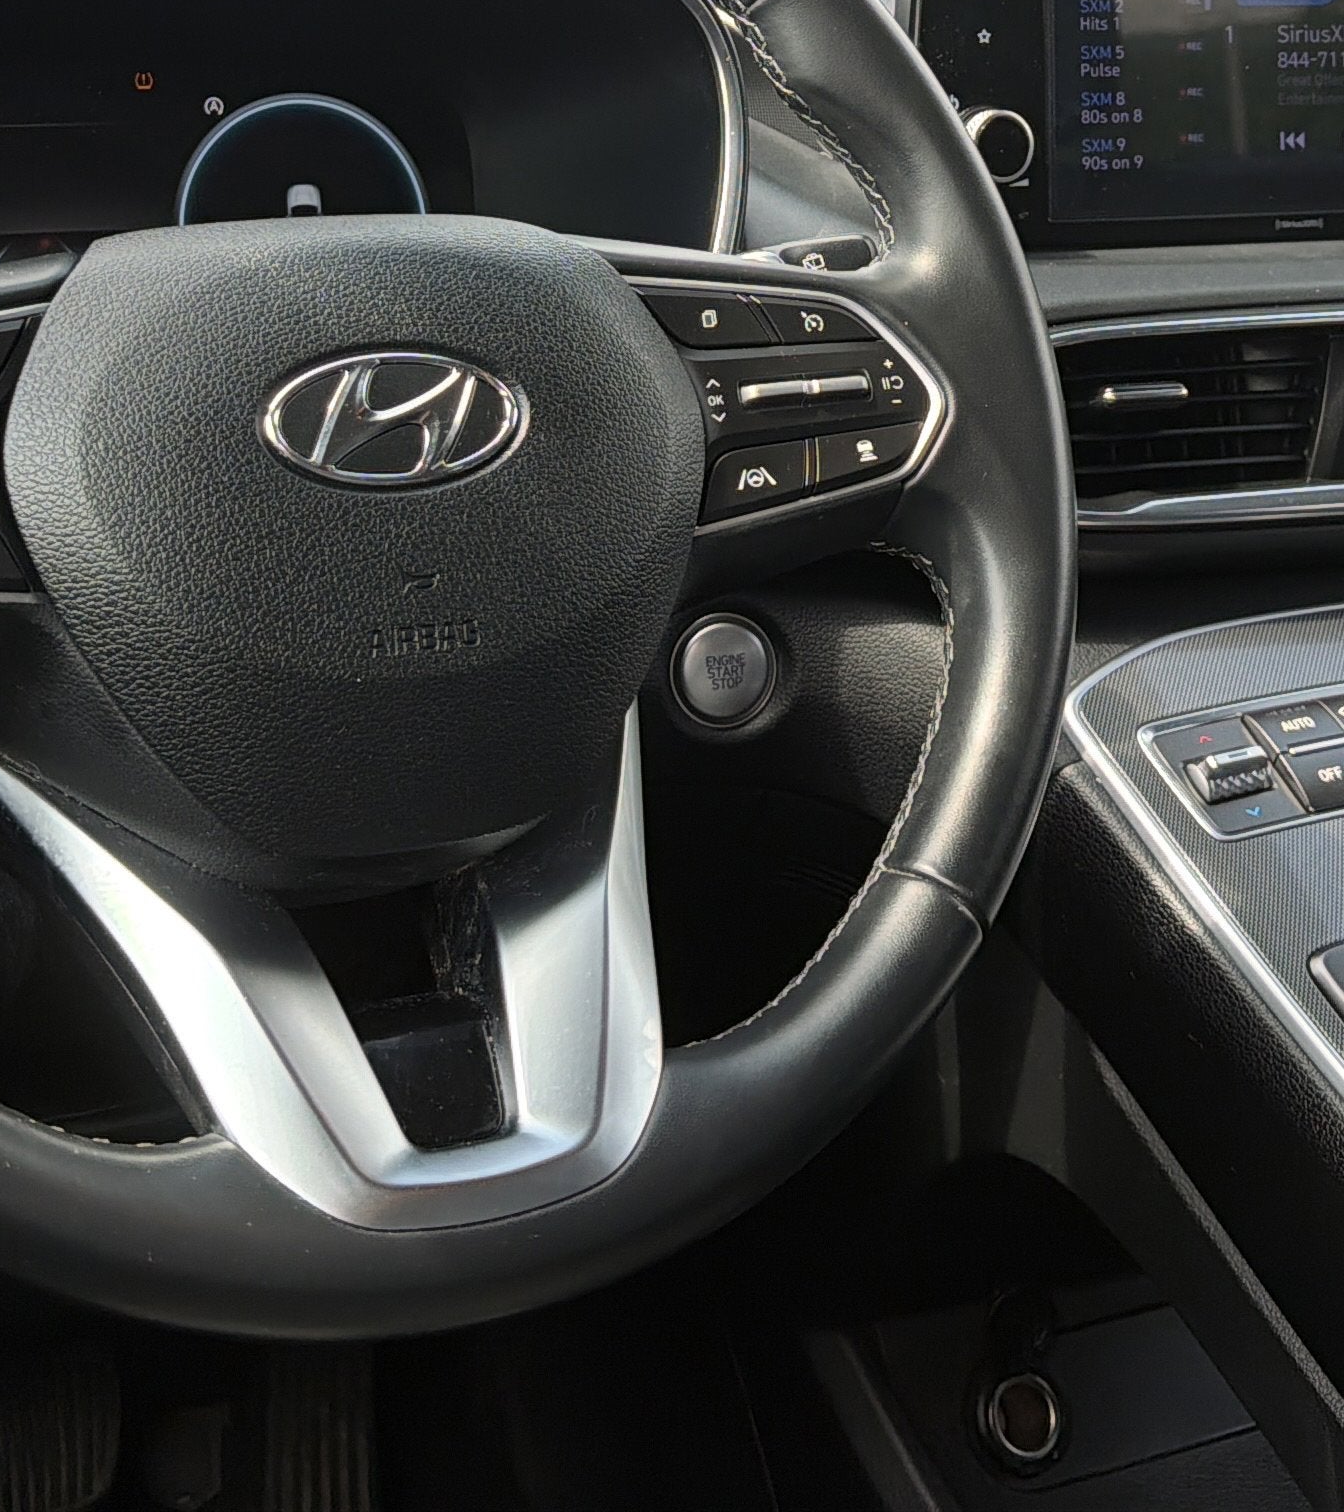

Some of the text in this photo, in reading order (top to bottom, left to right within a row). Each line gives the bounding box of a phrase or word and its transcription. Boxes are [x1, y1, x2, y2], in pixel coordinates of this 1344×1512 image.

[1079, 17, 1120, 31] Hits 1
[1225, 25, 1233, 44] 1
[1080, 45, 1125, 60] SXM 5
[1080, 63, 1121, 78] Pulse
[1081, 91, 1126, 106] SXM 8
[1081, 108, 1143, 124] 80s on 8
[1081, 138, 1126, 153] SXM 9
[1081, 154, 1144, 171] 90s on 9
[707, 394, 725, 407] OK
[706, 652, 746, 667] ENGINE
[707, 664, 745, 679] START
[712, 676, 743, 690] STOP
[1281, 716, 1316, 733] AUTO
[1317, 765, 1343, 783] OFF
